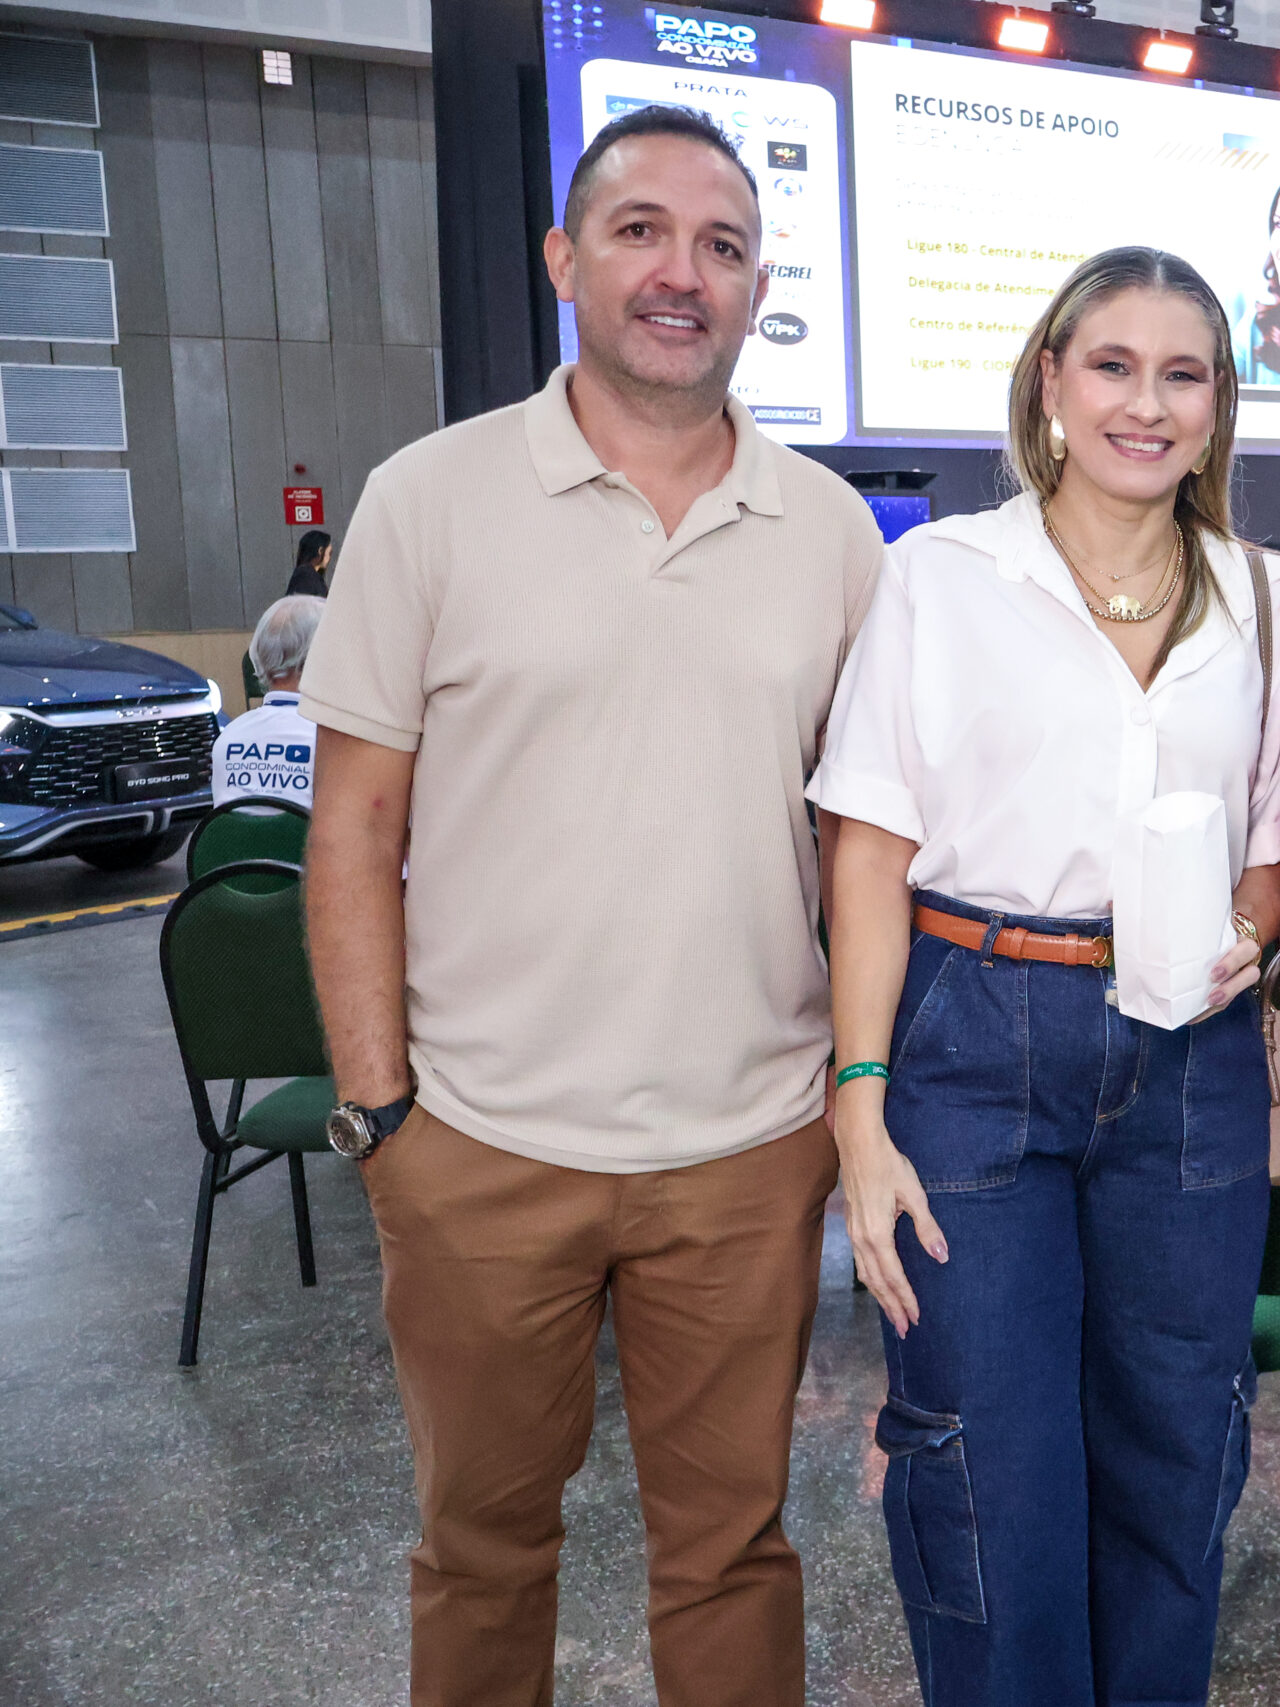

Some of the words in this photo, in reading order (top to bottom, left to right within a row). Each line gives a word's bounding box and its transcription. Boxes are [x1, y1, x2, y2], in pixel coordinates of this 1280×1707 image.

[655, 15, 757, 43] PAPO
[657, 40, 693, 55] AO
[695, 46, 757, 63] VIVO
[674, 81, 747, 97] PRATA
[896, 93, 1013, 125] RECURSOS
[1020, 109, 1045, 129] DE
[1052, 114, 1119, 138] APOIO
[907, 239, 942, 254] Ligue
[947, 242, 968, 254] 180
[980, 245, 1026, 259] Central
[1030, 250, 1044, 260] de
[909, 276, 971, 293] Delegacia
[975, 283, 989, 292] de
[910, 317, 953, 330] Centro
[959, 321, 972, 331] de
[911, 357, 945, 371] Ligue
[951, 359, 971, 371] 190
[226, 743, 311, 763] PAPO
[225, 762, 310, 774] CONDOMINIAL
[127, 778, 147, 787] BYD
[147, 775, 171, 785] SONG
[171, 772, 190, 781] PRO
[227, 772, 251, 787] AO
[258, 772, 309, 790] VIVO
